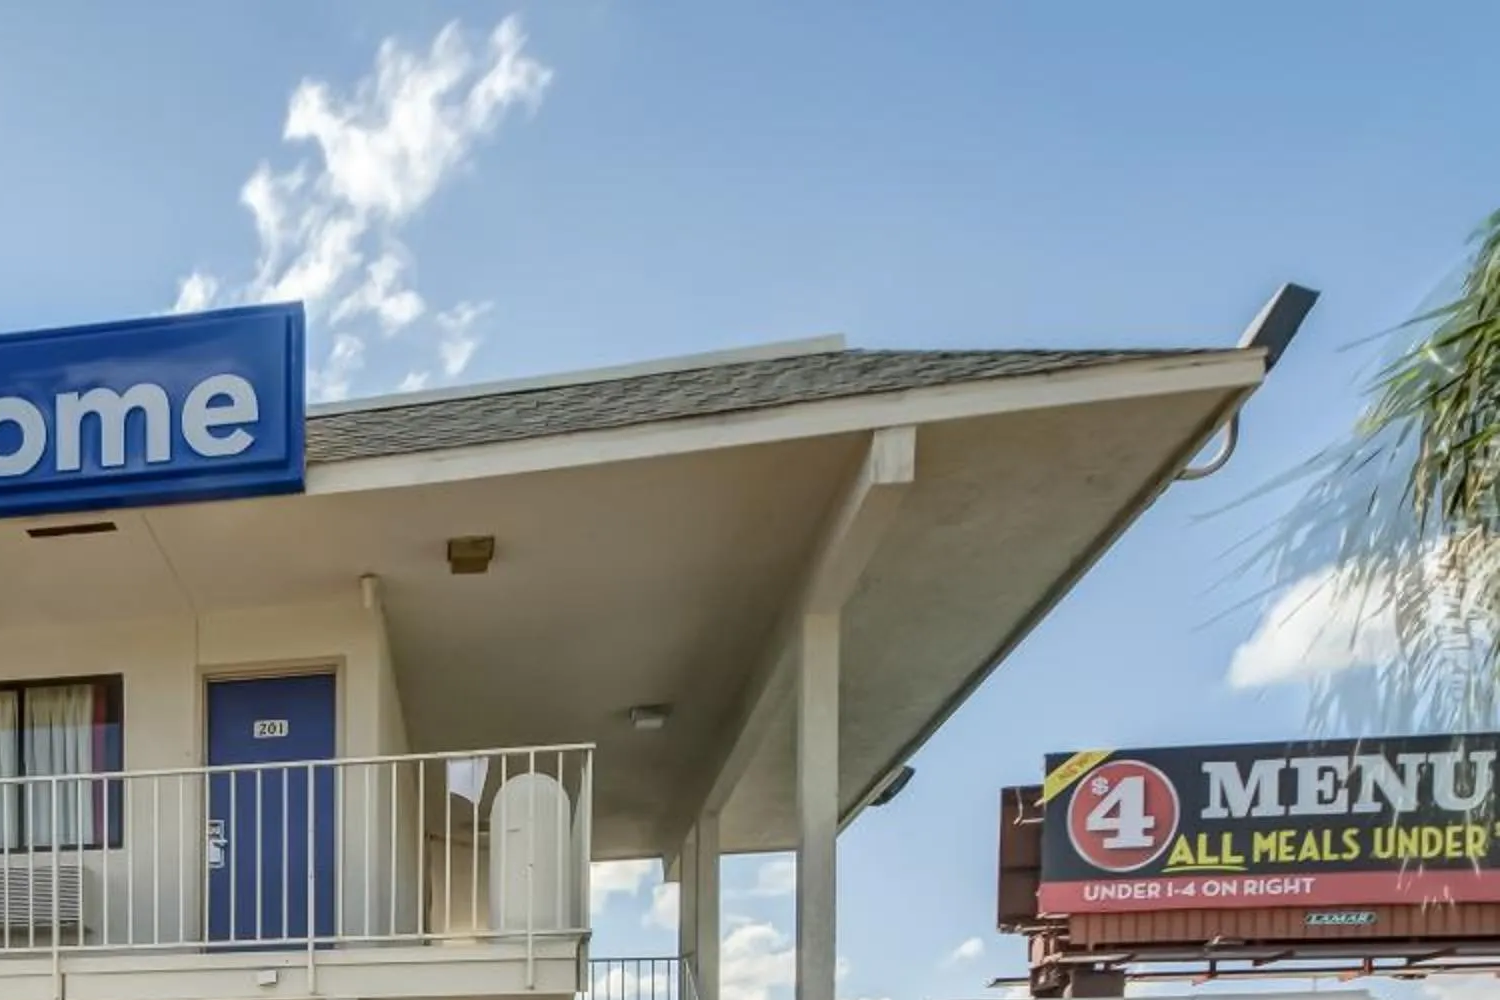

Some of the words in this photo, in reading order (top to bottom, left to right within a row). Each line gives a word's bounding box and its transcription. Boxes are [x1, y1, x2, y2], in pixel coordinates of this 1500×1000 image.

[259, 722, 283, 735] 201
[1201, 751, 1497, 818] MENU
[1085, 775, 1155, 849] $4
[1166, 832, 1245, 866] ALL
[1253, 827, 1361, 863] MEALS
[1373, 824, 1487, 860] UNDER
[1083, 882, 1160, 901] UNDER
[1167, 881, 1196, 898] I-4
[1202, 880, 1237, 897] ON
[1243, 877, 1316, 896] RIGHT
[1306, 912, 1370, 925] LAMAR
